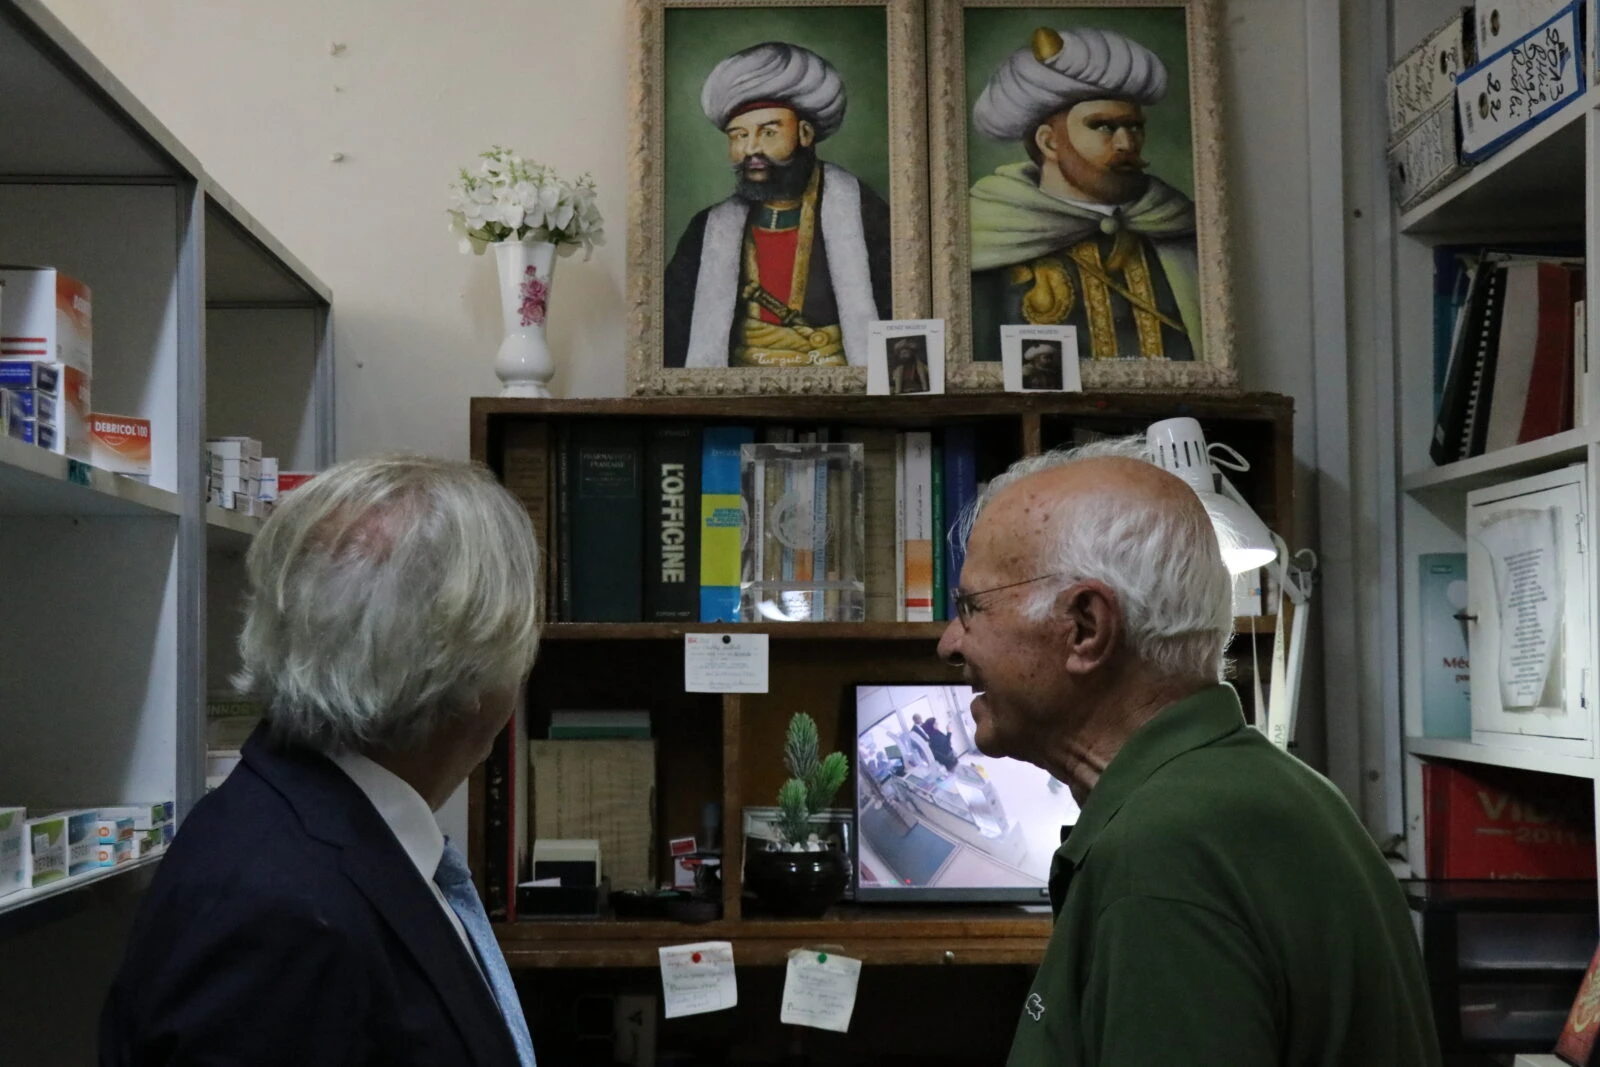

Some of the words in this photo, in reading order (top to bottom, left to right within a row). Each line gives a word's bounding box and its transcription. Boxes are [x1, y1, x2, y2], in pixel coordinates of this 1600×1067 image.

[1546, 27, 1565, 102] 2013
[752, 351, 803, 368] Turgut
[94, 421, 137, 436] DEBRICOL
[661, 463, 686, 584] L'OFFICINE
